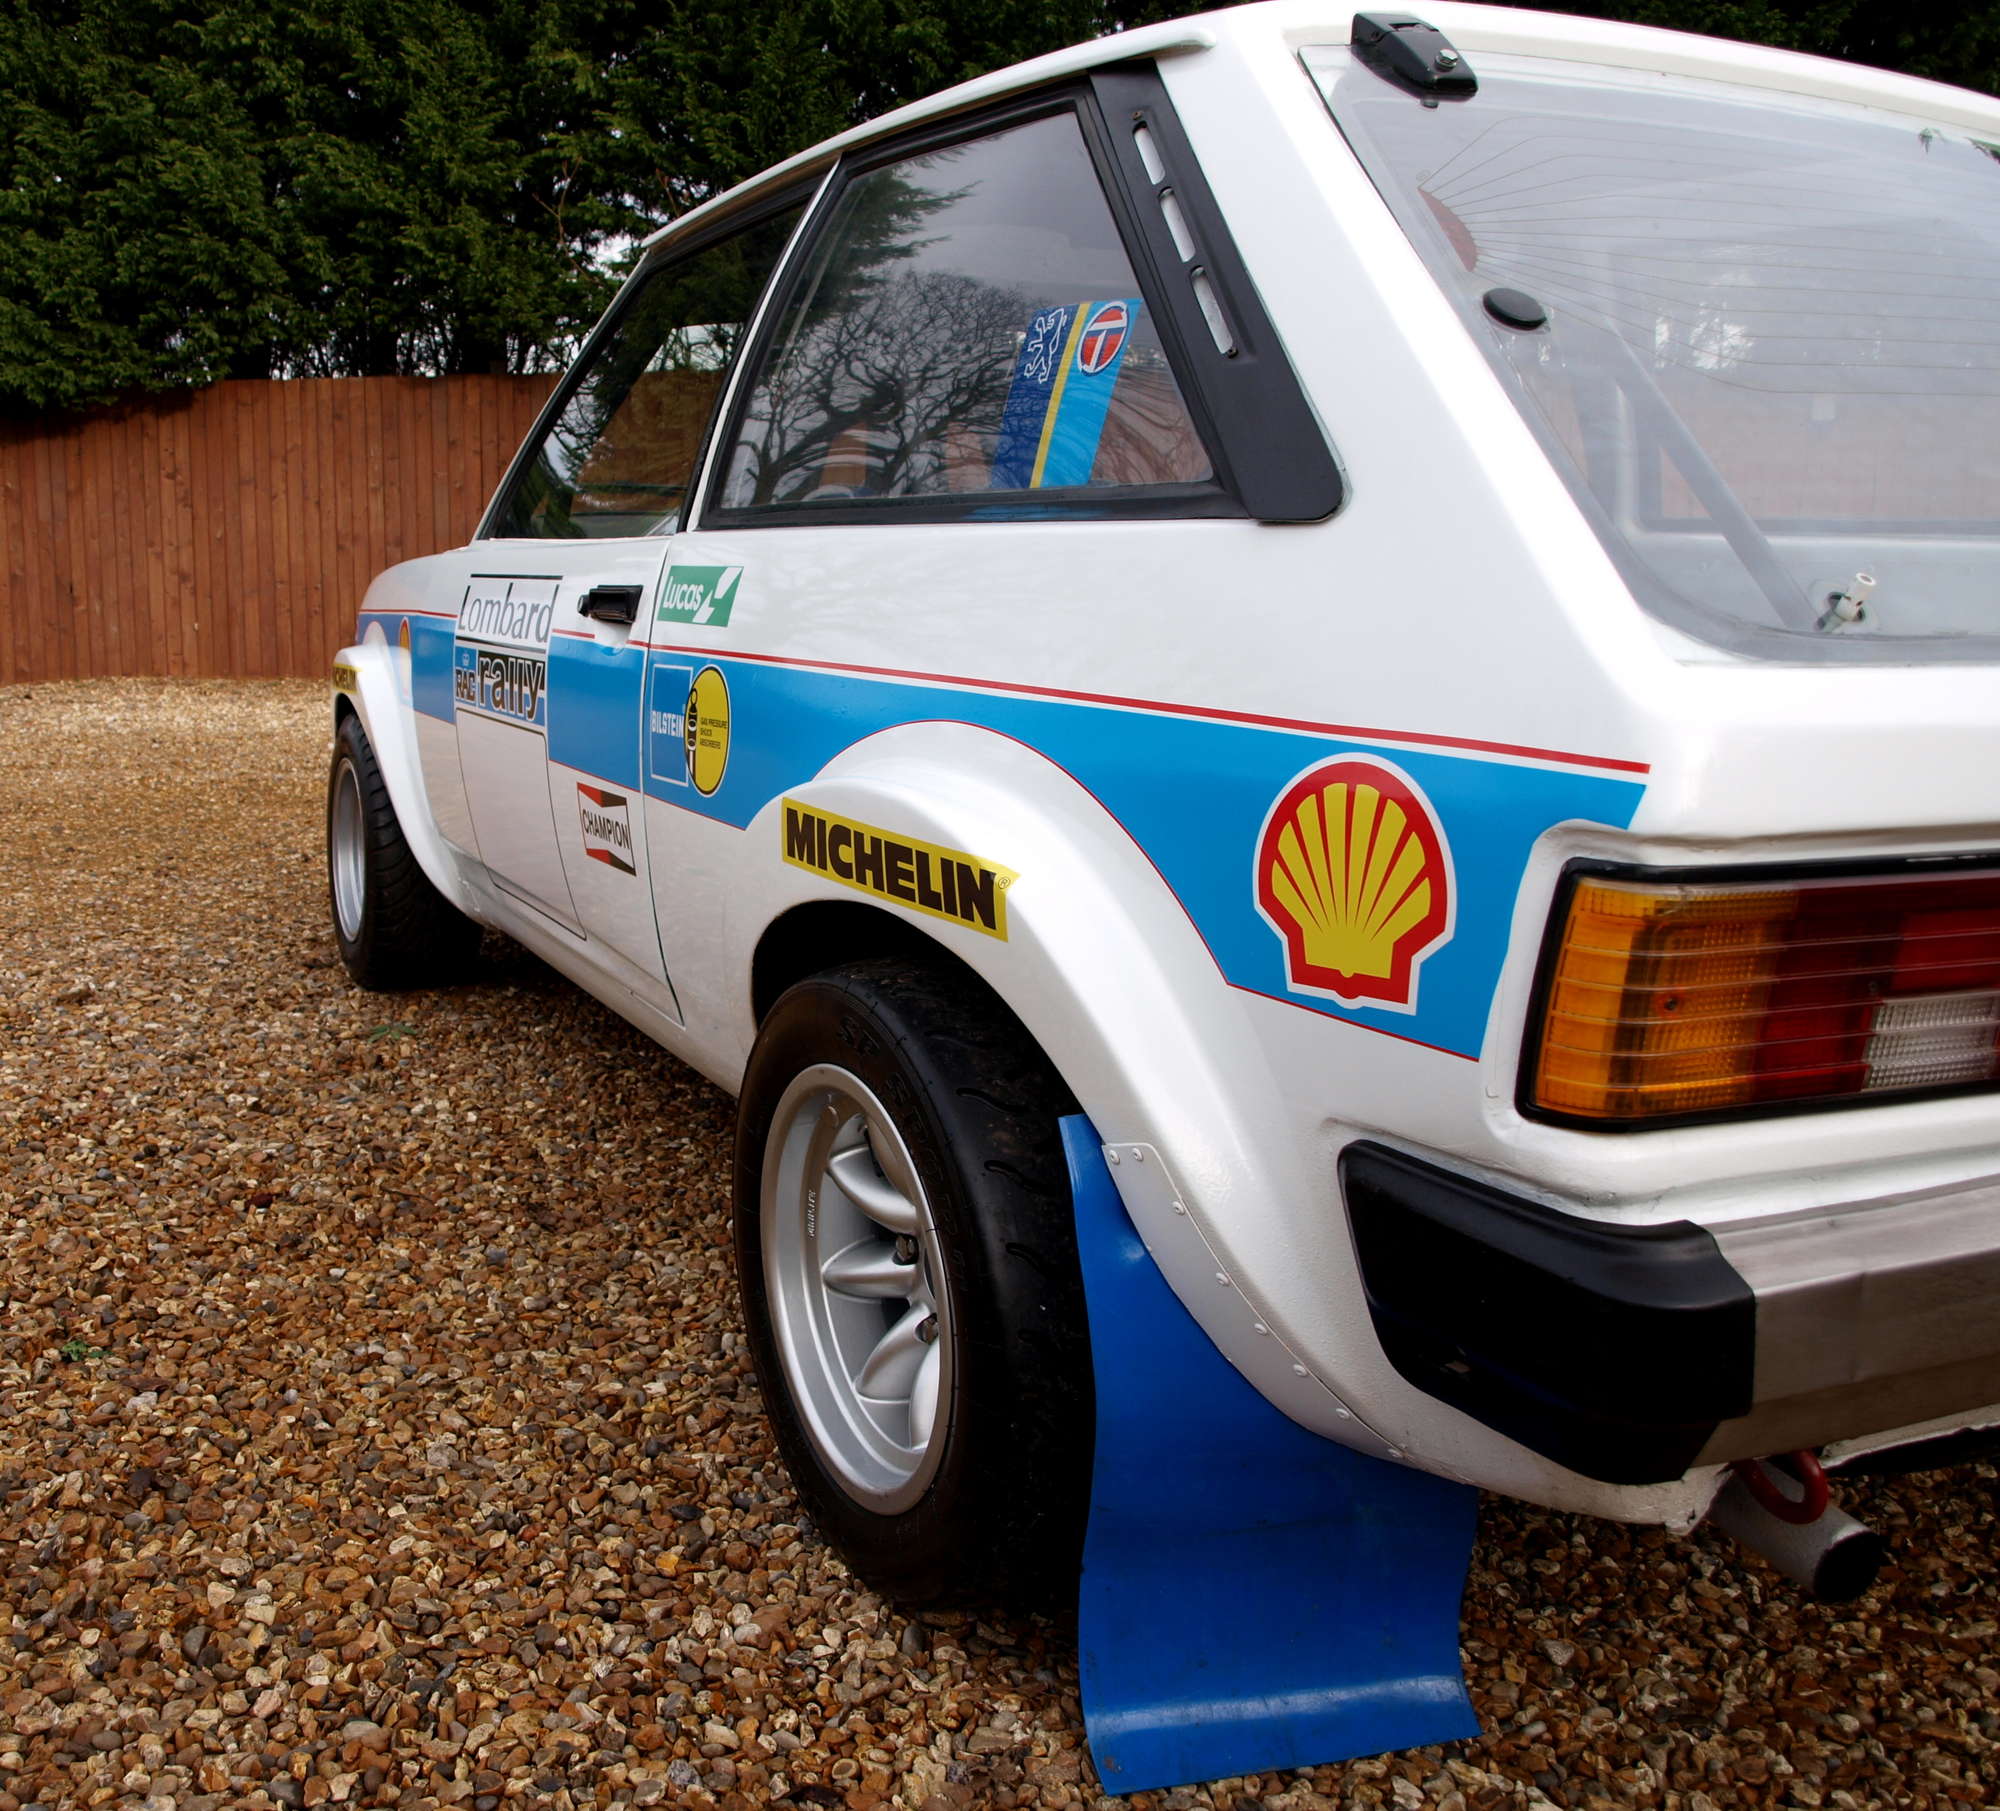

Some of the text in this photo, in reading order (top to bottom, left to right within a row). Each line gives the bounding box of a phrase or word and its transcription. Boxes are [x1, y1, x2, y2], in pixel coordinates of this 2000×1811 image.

[458, 582, 560, 643] Lombard
[663, 575, 705, 612] Lucas
[455, 655, 545, 722] RAC rally
[651, 709, 685, 738] BILSTEIN
[582, 808, 630, 849] CHAMPION
[786, 807, 997, 931] MICHELIN
